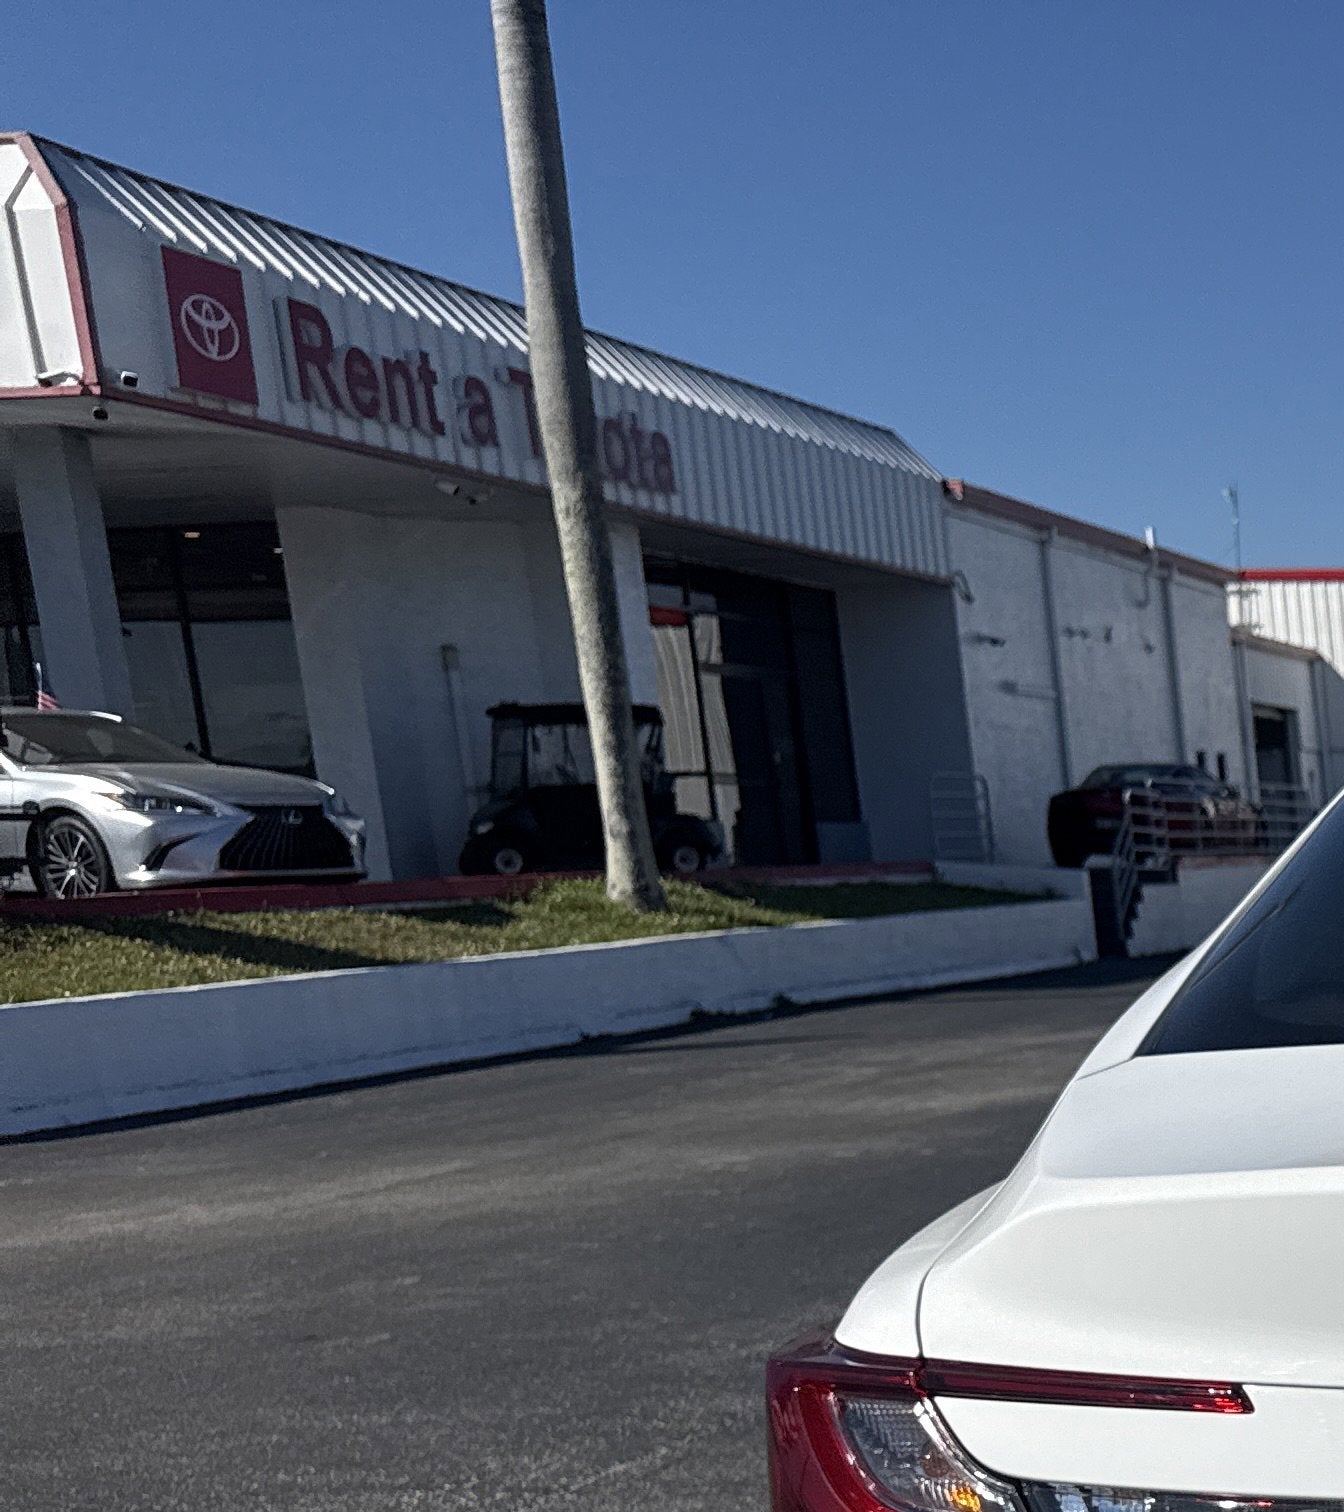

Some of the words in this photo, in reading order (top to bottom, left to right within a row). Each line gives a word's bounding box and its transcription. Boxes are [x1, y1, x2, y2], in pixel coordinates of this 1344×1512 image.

[287, 298, 446, 437] Rent
[464, 375, 498, 448] a
[507, 367, 675, 495] Tota
